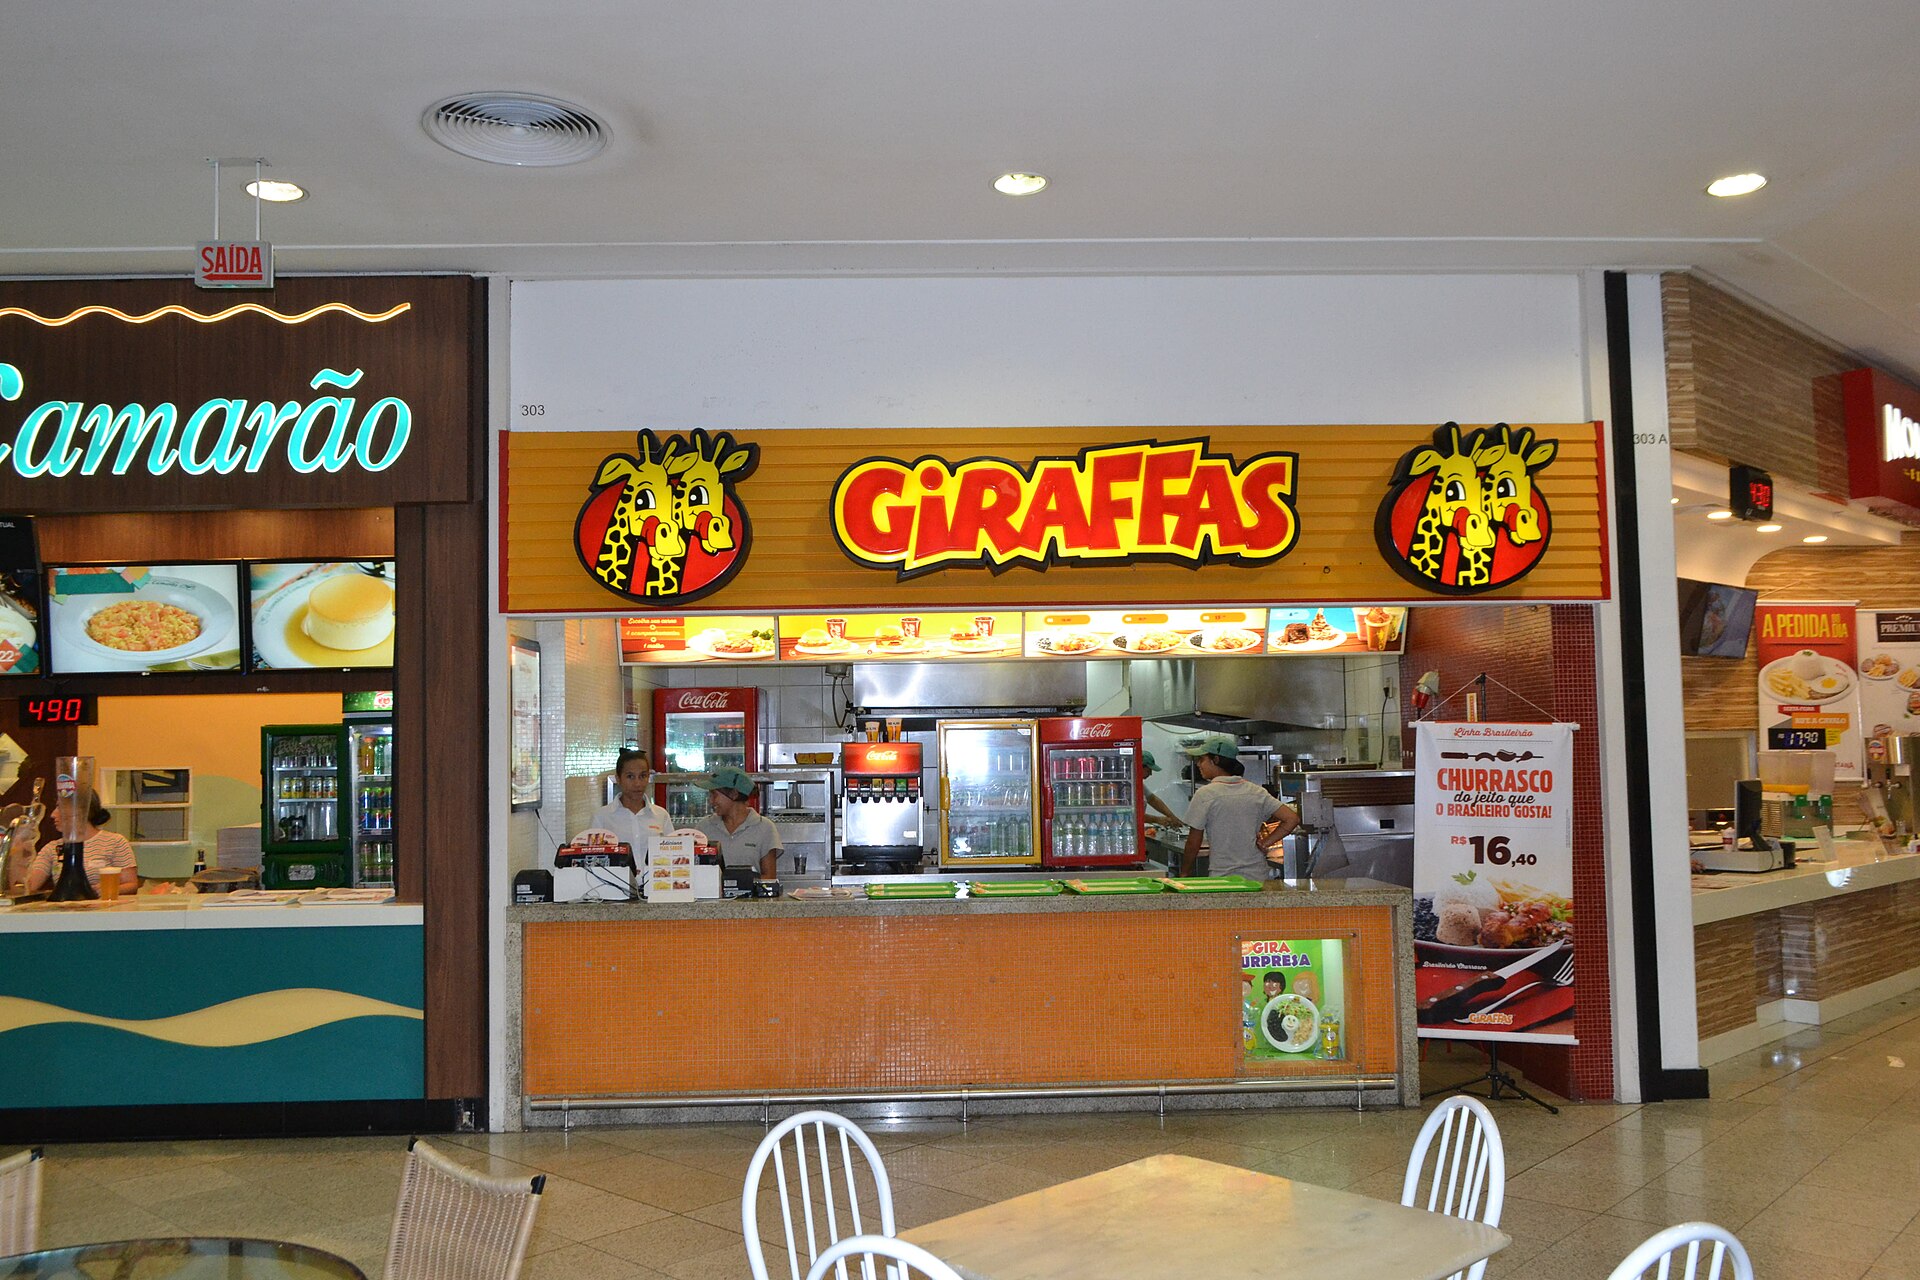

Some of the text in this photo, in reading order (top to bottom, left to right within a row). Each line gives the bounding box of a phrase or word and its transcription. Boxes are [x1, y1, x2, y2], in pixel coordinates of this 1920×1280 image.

[201, 243, 263, 273] SAÍDA
[521, 404, 545, 416] 303
[1632, 433, 1668, 445] 303 A
[1762, 613, 1830, 638] A PEDIDA
[679, 691, 730, 709] Coca-Cola
[28, 698, 82, 722] 490
[1454, 727, 1534, 738] Linha Brasileirão
[1437, 767, 1553, 793] CHURRASCO
[1454, 791, 1535, 808] do jeito que
[1436, 803, 1552, 819] O BRASILEIRO GOSTA!
[1451, 835, 1537, 867] R$ 16,40
[1253, 941, 1291, 954] GIRA
